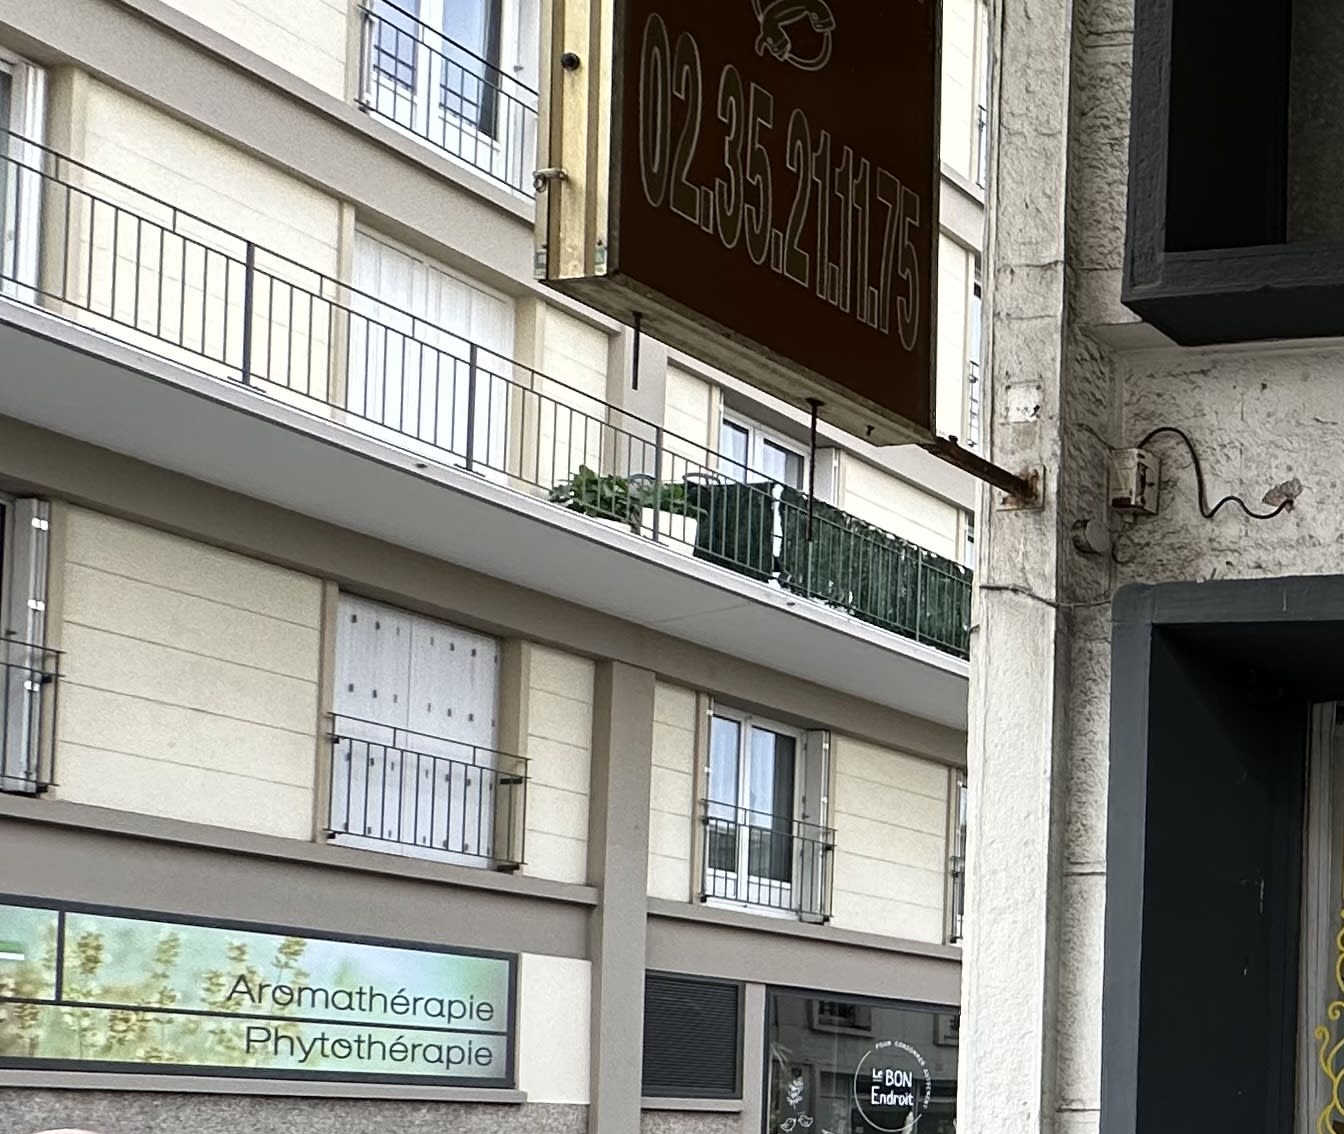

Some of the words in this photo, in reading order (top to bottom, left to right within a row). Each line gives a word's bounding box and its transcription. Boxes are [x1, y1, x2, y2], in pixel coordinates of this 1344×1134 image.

[640, 12, 921, 351] 02.35.21.11.75
[226, 974, 495, 1024] Aromathérapie
[245, 1026, 493, 1070] Phytothérapie
[871, 1085, 914, 1106] Endroit
[872, 1068, 884, 1079] Le
[885, 1069, 912, 1088] BON
